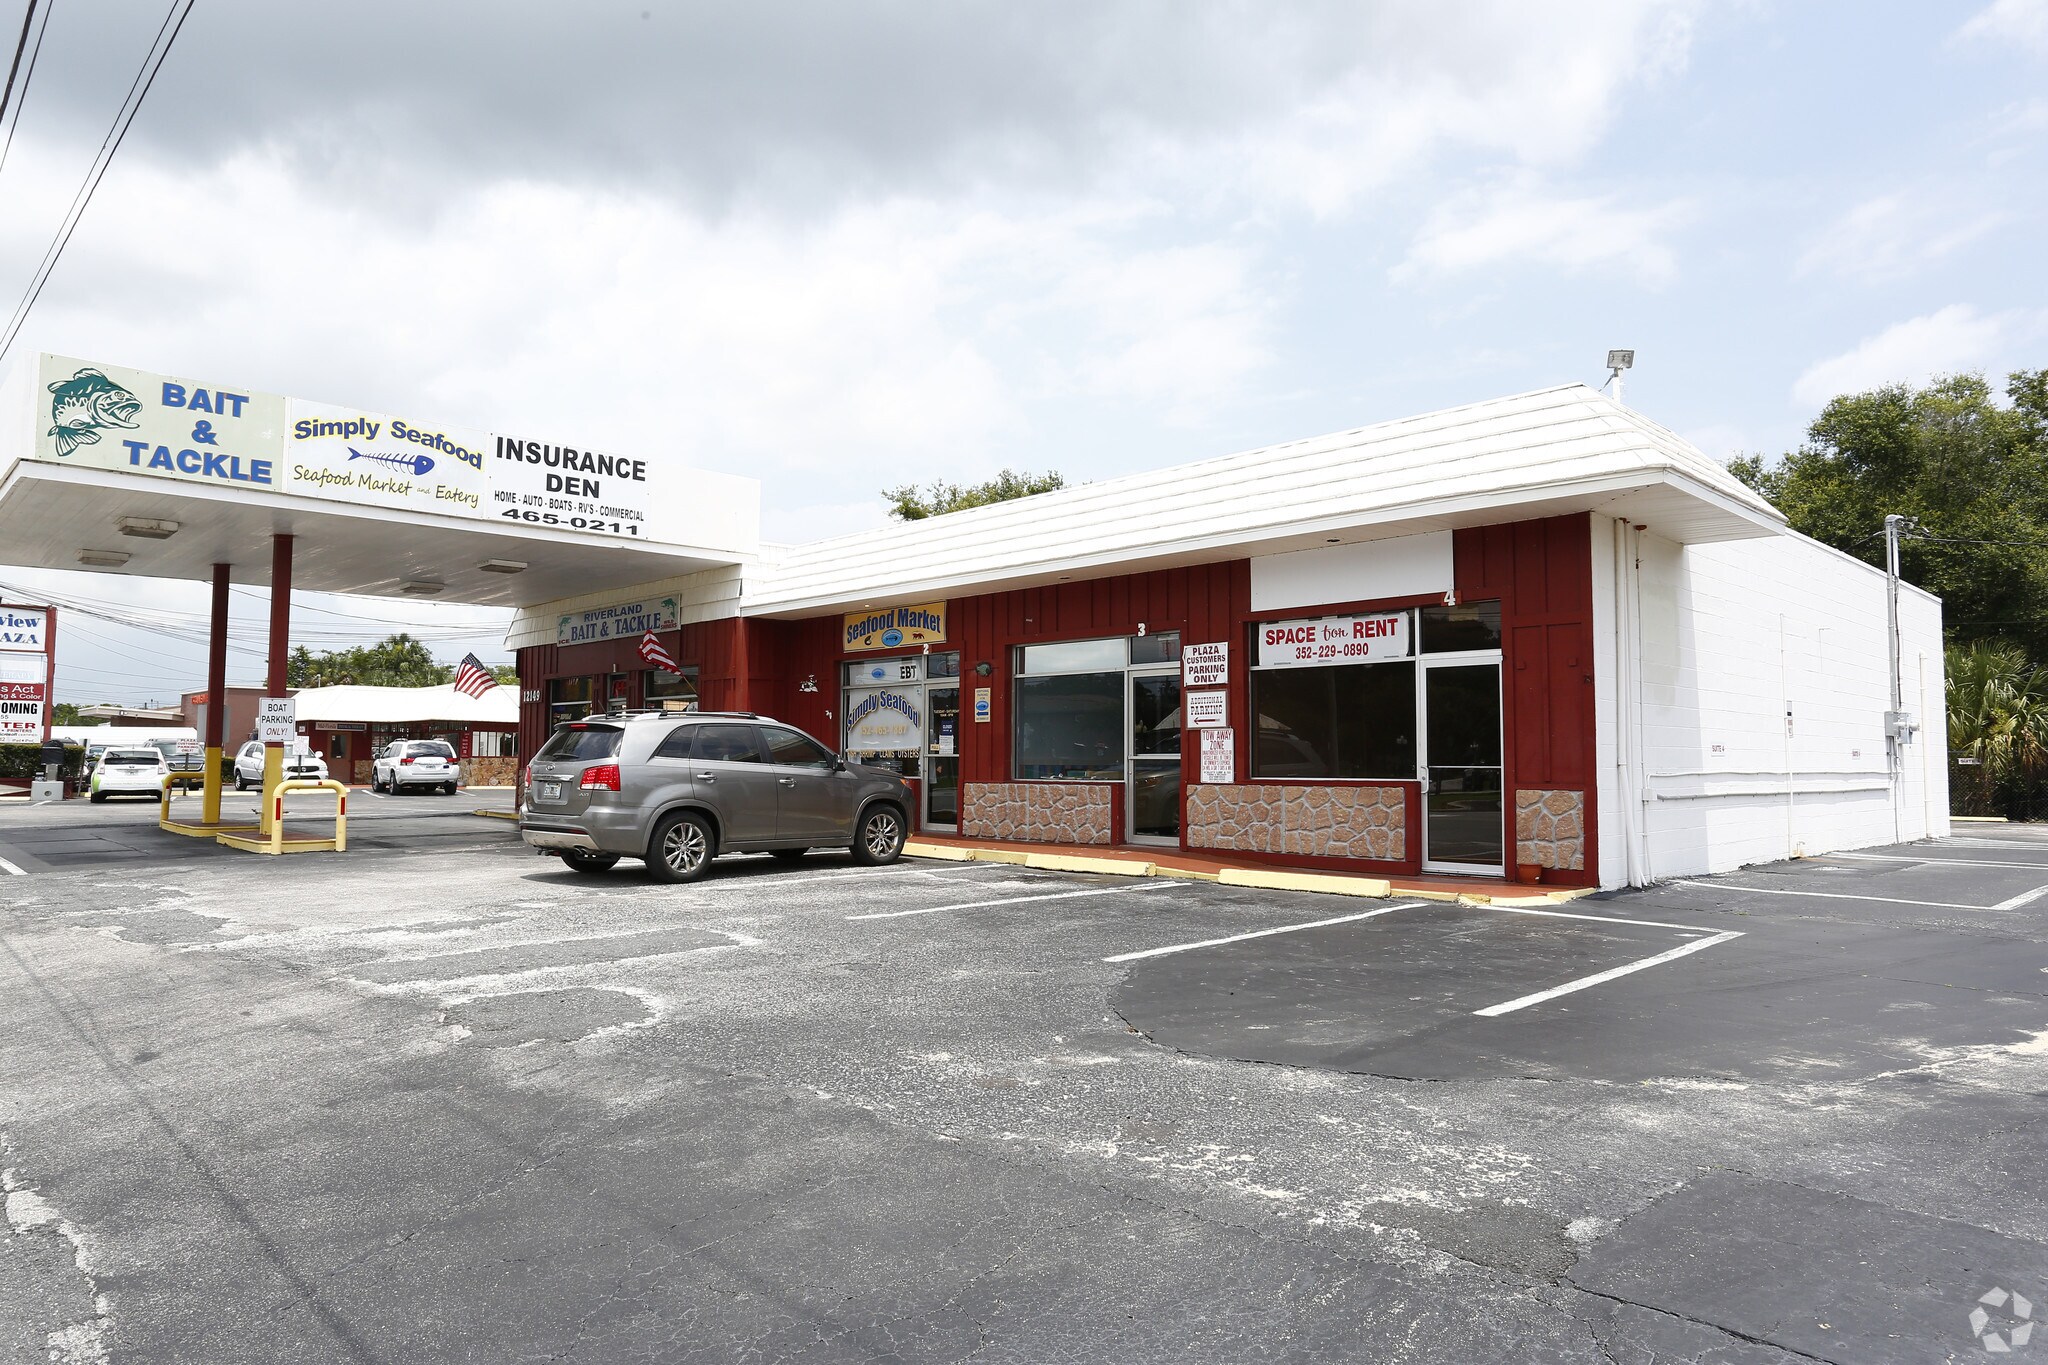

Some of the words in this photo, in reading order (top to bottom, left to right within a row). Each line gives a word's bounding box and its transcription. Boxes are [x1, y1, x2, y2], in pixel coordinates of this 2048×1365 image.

[162, 382, 249, 418] BAIT
[191, 420, 219, 446] &
[294, 418, 380, 440] Simply
[391, 421, 482, 469] Seafood
[122, 440, 272, 484] TACKLE
[496, 436, 646, 481] INSURANCE
[293, 465, 354, 487] Seafood
[358, 474, 412, 495] Market
[417, 487, 431, 495] and
[435, 485, 479, 508] Eatery
[546, 473, 600, 498] DEN
[494, 490, 516, 503] HOME
[523, 494, 543, 507] AUTO
[549, 498, 573, 512] BOATS
[578, 502, 594, 515] RV'S
[599, 505, 644, 522] COMMERCIAL
[501, 508, 638, 536] 465-0211
[1443, 589, 1456, 606] 4
[584, 604, 643, 622] RIVERLAND
[571, 623, 597, 641] BAIT
[600, 621, 609, 637] &
[614, 612, 661, 635] TACKLE
[847, 609, 895, 644] Seafood
[898, 607, 941, 633] Market
[1137, 622, 1145, 637] 3
[1265, 626, 1316, 645] SPACE
[1321, 625, 1348, 642] for
[1353, 618, 1398, 639] RENT
[923, 643, 929, 655] 2
[1192, 645, 1220, 656] PLAZA
[1295, 642, 1369, 660] 352-229-0890
[1186, 654, 1226, 665] CUSTOMERS
[900, 665, 917, 680] EBT
[1188, 664, 1225, 675] PARKING
[1193, 674, 1218, 683] ONLY
[12, 684, 35, 693] Act
[268, 704, 287, 712] BOAT
[848, 693, 878, 733] Simply
[880, 690, 919, 728] Seafood
[1190, 704, 1223, 715] PARKING
[262, 715, 293, 724] PARKING
[266, 728, 288, 736] ONLY!
[1202, 730, 1214, 740] TOW
[1216, 730, 1232, 740] AWAY
[1210, 740, 1224, 750] ZONE
